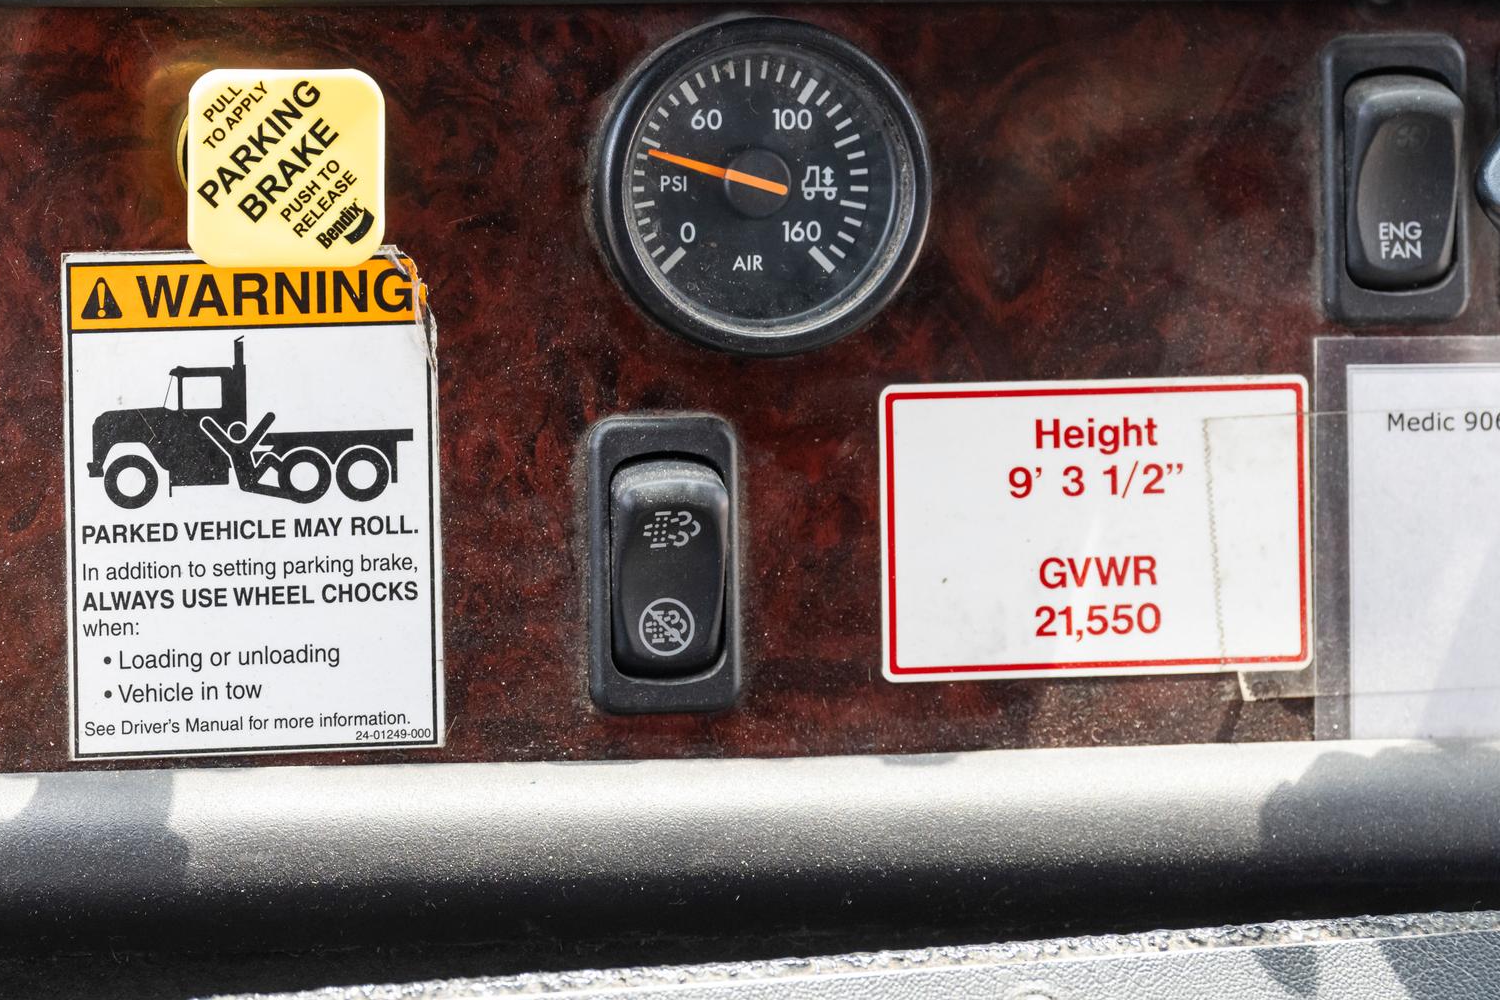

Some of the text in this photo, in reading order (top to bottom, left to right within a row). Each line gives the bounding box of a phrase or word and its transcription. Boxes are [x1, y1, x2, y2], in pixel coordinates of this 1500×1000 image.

[203, 86, 243, 123] PULL
[203, 81, 269, 149] TO APPLY
[691, 108, 723, 130] 60
[772, 108, 813, 130] 100
[197, 80, 321, 209] PARKING
[237, 117, 340, 223] BRAKE
[660, 175, 687, 192] PSI
[279, 159, 340, 223] PUSH TO
[292, 169, 358, 238] RELEASE
[315, 200, 364, 249] Bendix
[680, 222, 696, 243] 0
[782, 221, 822, 242] 160
[1378, 221, 1422, 241] ENG
[732, 254, 764, 271] AIR
[1380, 240, 1422, 259] FAN
[136, 268, 415, 319] WARNING
[1034, 416, 1158, 455] Height
[1387, 411, 1455, 432] Medic
[1008, 464, 1044, 499] 9'
[1062, 465, 1085, 497] 3
[81, 515, 419, 545] PARKED VEHICLE MAY ROLL.
[82, 553, 419, 582] In addition to setting parking brake,
[1038, 555, 1158, 589] GVWR
[82, 581, 419, 612] ALWAYS USE WHEEL CHOCKS
[82, 619, 140, 637] when:
[1034, 602, 1162, 643] 21,550
[118, 644, 340, 673] Loading or unloading
[118, 681, 262, 703] Vehicle in tow
[84, 711, 411, 737] See Driver's Manual for more information.
[355, 728, 432, 741] 24-01249-000
